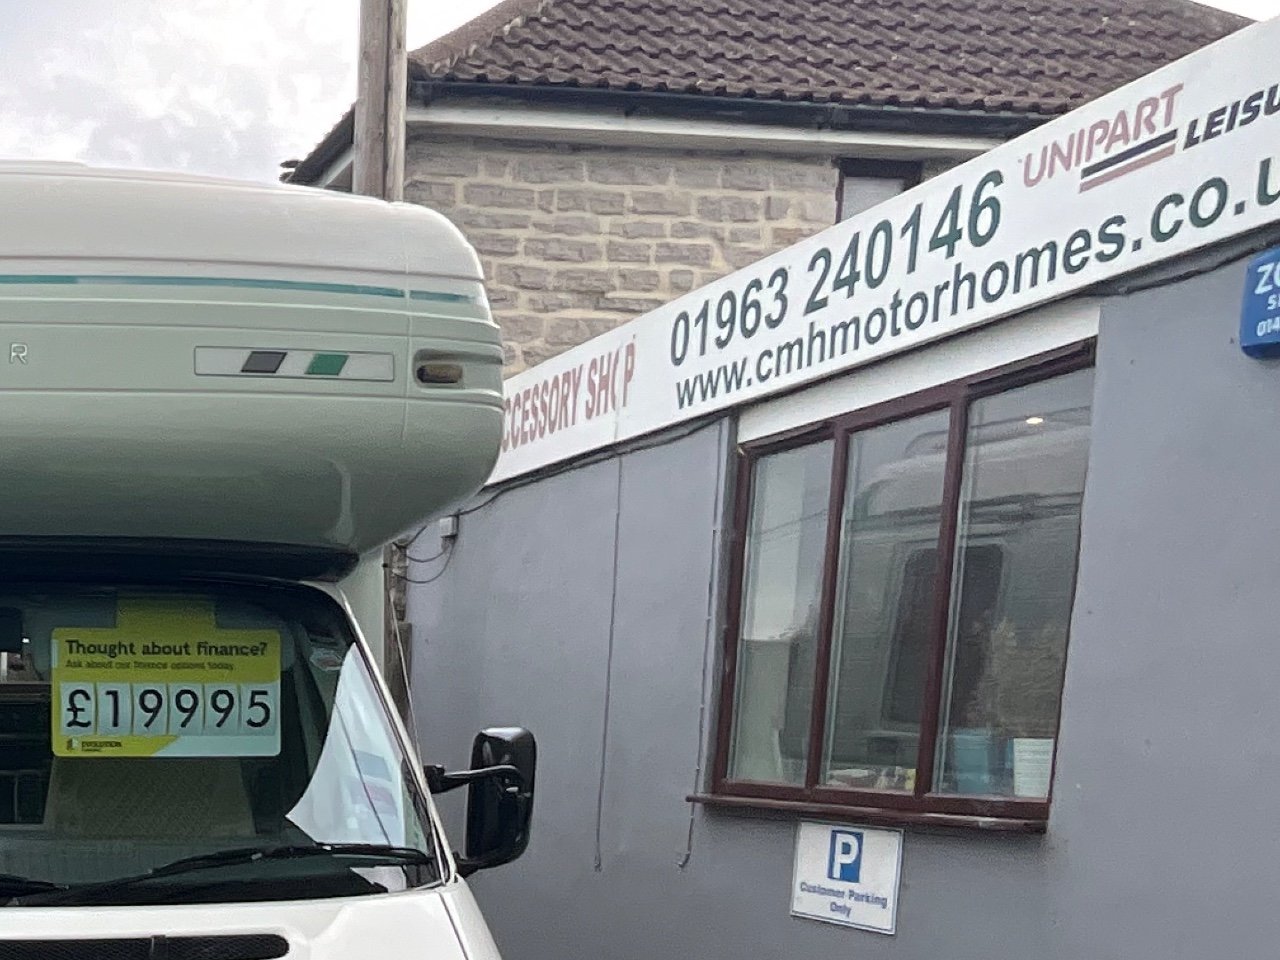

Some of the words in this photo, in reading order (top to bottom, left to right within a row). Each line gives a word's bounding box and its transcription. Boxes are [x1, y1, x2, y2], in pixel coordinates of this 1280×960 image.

[1023, 82, 1184, 188] UNIPART
[670, 267, 789, 366] 01963
[803, 170, 1004, 316] 240146
[65, 640, 137, 658] Thought
[142, 641, 191, 656] about
[196, 641, 268, 656] finance?
[65, 659, 83, 668] Ask
[87, 660, 113, 669] about
[66, 688, 271, 728] £19995
[833, 833, 859, 879] P
[800, 881, 845, 899] Customer
[848, 889, 888, 909] Parking
[830, 901, 852, 918] Only
